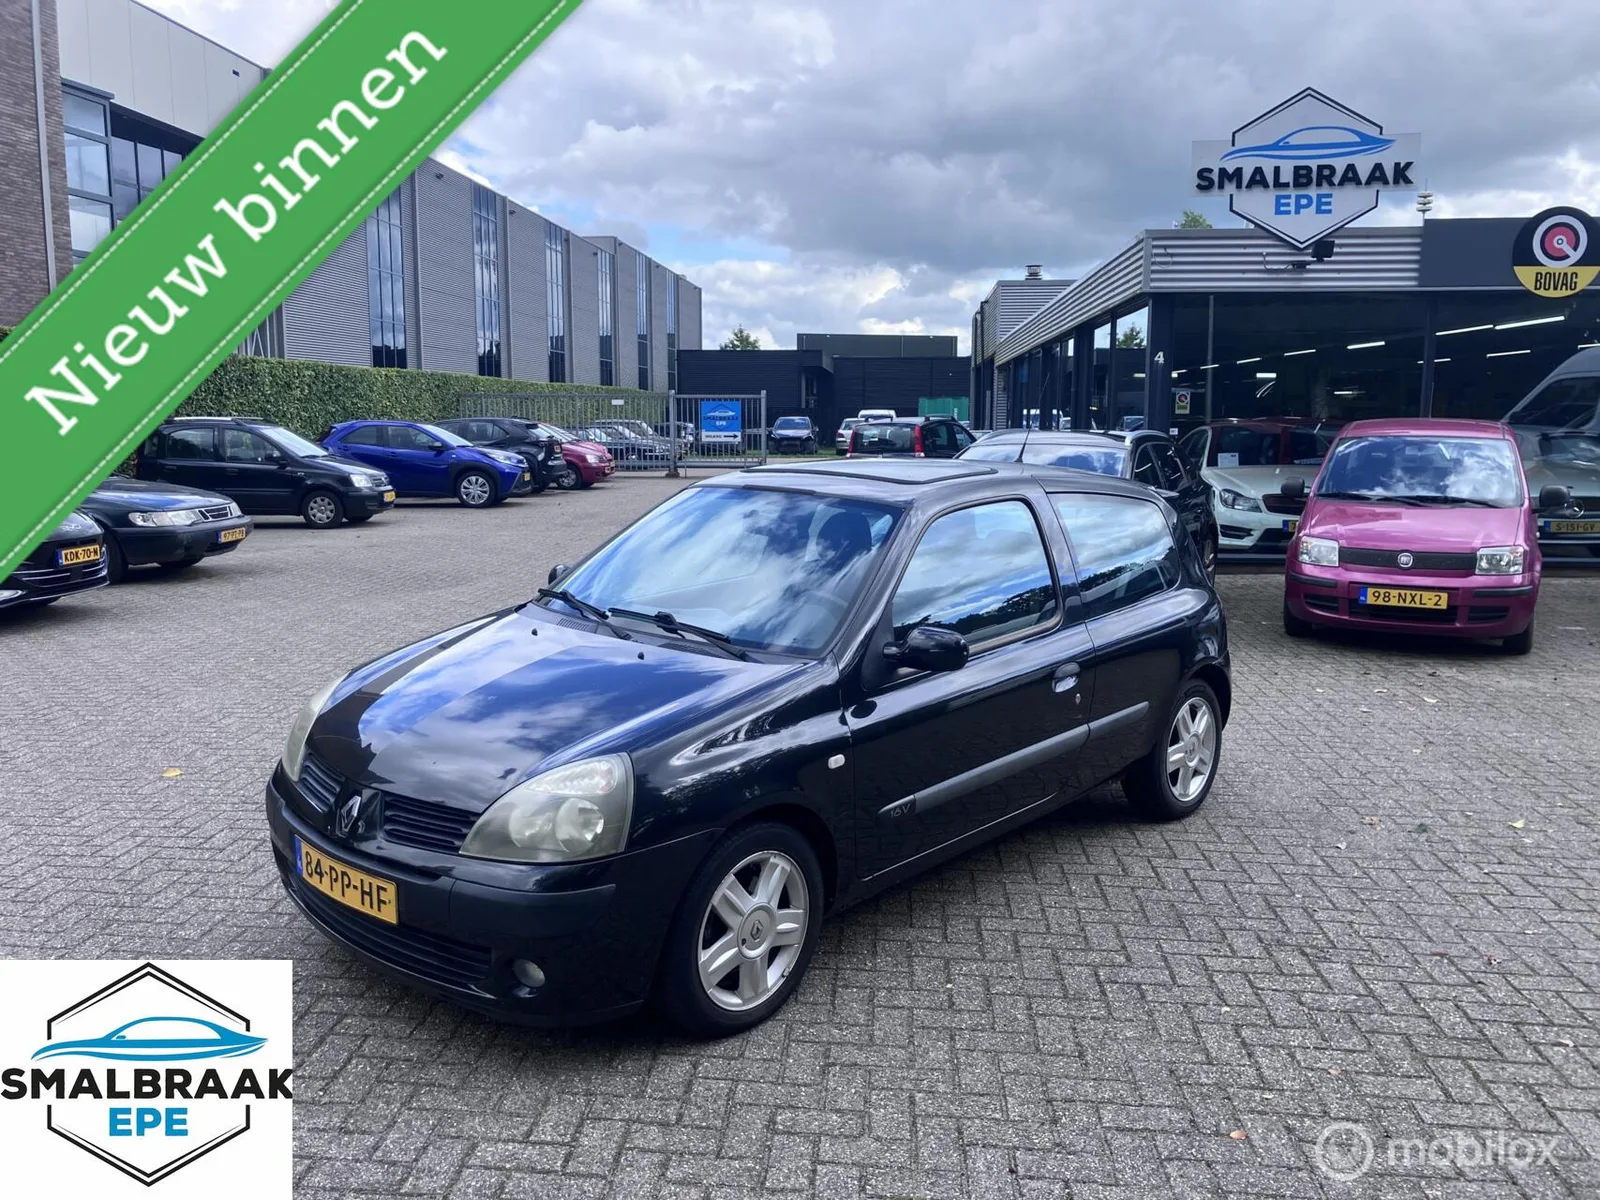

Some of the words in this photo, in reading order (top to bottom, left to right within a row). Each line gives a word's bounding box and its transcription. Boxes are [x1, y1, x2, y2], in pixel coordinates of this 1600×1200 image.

[1196, 161, 1415, 191] SMALBRAAK
[1274, 193, 1334, 216] EPE
[1534, 271, 1579, 291] BOVAG
[1154, 351, 1165, 364] 4
[63, 546, 99, 563] KDK-70-N
[1372, 590, 1443, 607] 98-NXL-2
[305, 850, 388, 912] 84-PP-HF
